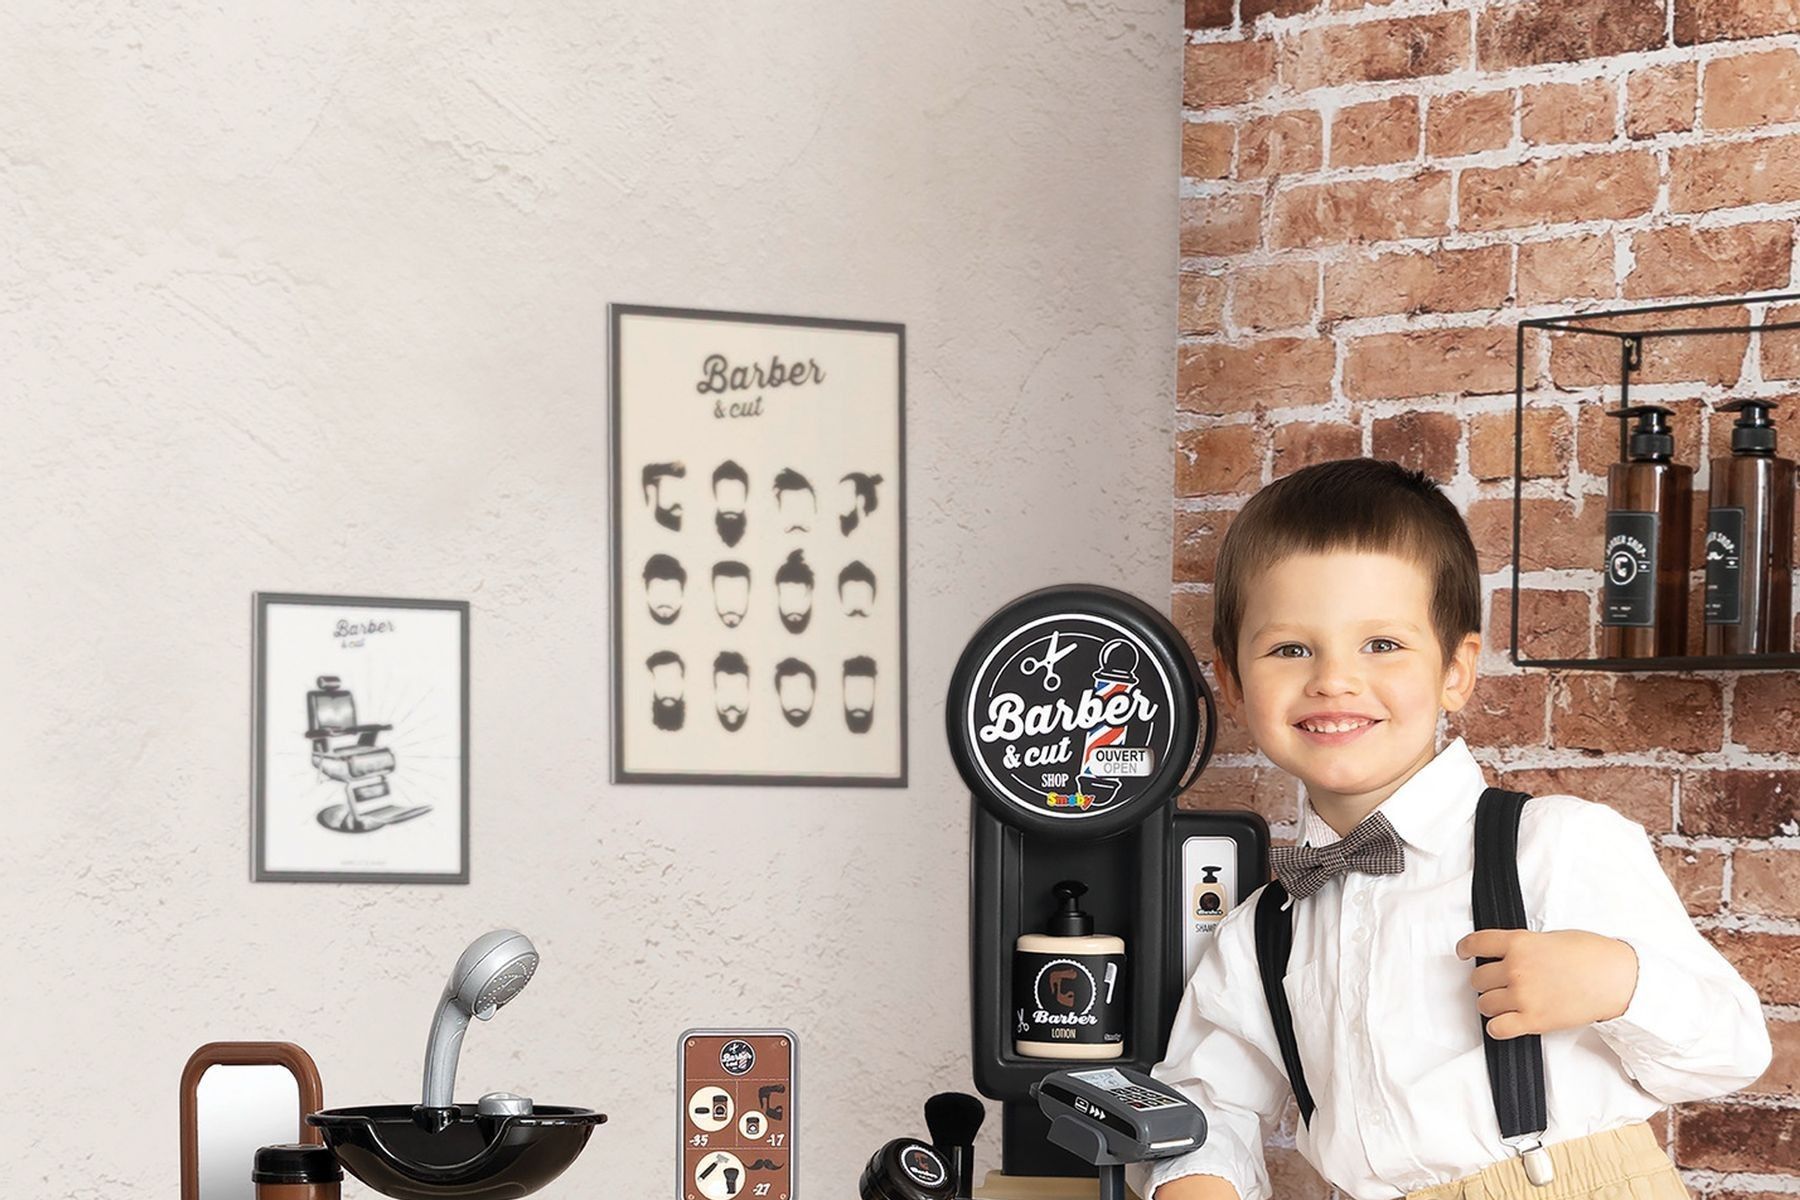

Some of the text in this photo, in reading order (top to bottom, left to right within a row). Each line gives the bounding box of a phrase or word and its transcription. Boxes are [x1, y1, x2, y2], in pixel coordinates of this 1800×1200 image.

[696, 354, 826, 394] Barber
[713, 396, 764, 419] & cut
[333, 618, 396, 638] Barber
[980, 689, 1158, 743] Barber
[1003, 736, 1072, 769] & cut
[1096, 750, 1145, 762] OUVERT
[1104, 763, 1137, 774] OPEN
[1041, 773, 1069, 788] SHOP
[1047, 792, 1096, 811] Smoby
[1032, 1010, 1098, 1025] Barber
[1051, 1028, 1076, 1039] LOTION
[752, 1183, 771, 1196] -27
